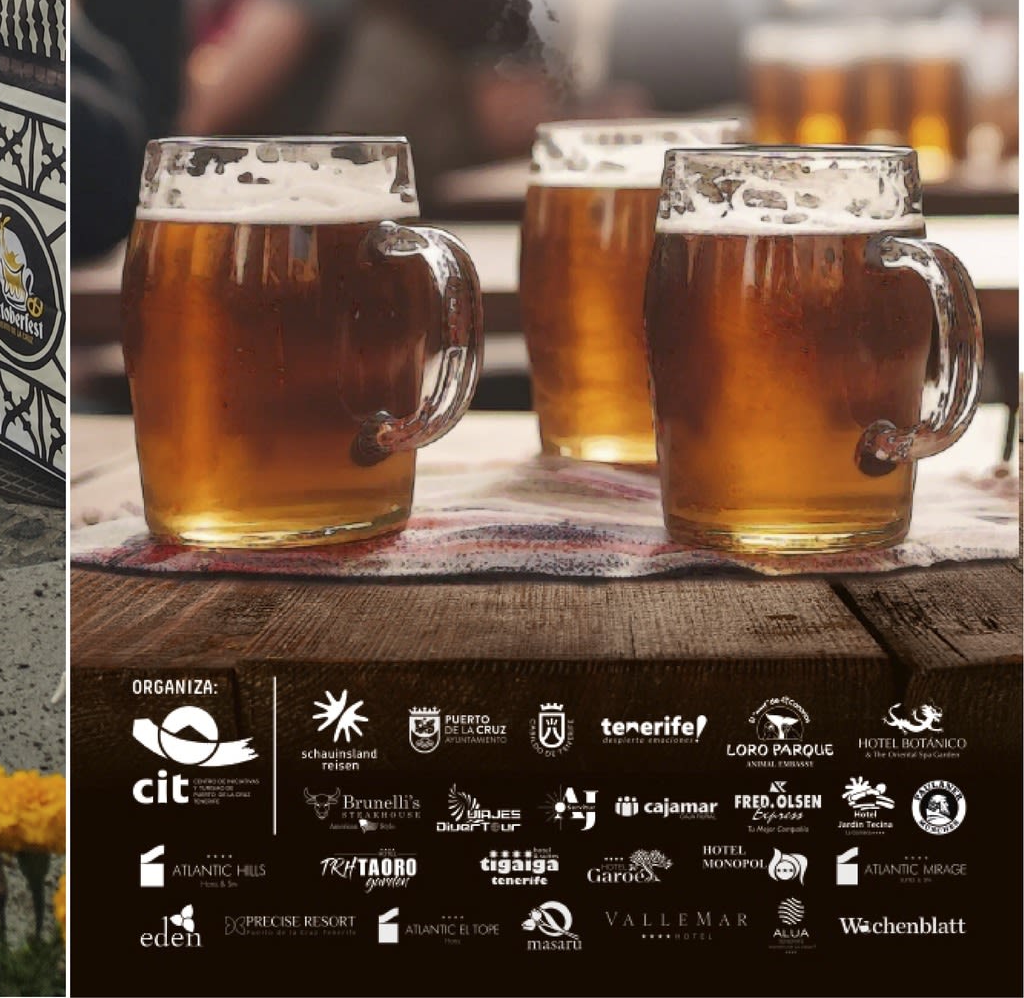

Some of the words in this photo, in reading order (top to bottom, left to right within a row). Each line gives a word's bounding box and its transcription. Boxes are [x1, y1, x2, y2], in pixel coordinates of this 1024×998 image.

[132, 679, 219, 696] ORGANIZA:
[445, 714, 490, 724] PUERTO
[445, 725, 458, 735] DE
[461, 725, 474, 735] LA
[476, 725, 507, 735] CRUZ
[445, 736, 507, 744] AYUNTAMIENTO
[858, 738, 899, 749] HOTEL
[902, 736, 967, 749] BOTÁNICO
[301, 748, 377, 759] schauinsland
[726, 744, 768, 758] LORO
[773, 744, 834, 758] PARQUE
[322, 760, 360, 771] reisen
[132, 769, 189, 804] cit
[914, 780, 963, 801] PAULANER
[342, 794, 421, 810] Brunelli's
[644, 797, 718, 818] cajamar
[342, 811, 421, 819] STEAKHOUSE
[752, 806, 804, 824] Express
[854, 810, 877, 818] Hotel
[703, 845, 746, 856] HOTEL
[172, 864, 232, 877] ATLANTIC
[237, 864, 267, 877] HILLS
[320, 856, 356, 879] TRH
[358, 857, 417, 877] TAORO
[480, 857, 559, 874] tigaiga
[702, 859, 767, 869] MONOPOL
[864, 864, 918, 876] ATLANTIC
[922, 864, 968, 876] MIRAGE
[364, 874, 411, 894] garden
[491, 875, 548, 886] tenerife
[246, 915, 301, 928] PRECISE
[304, 915, 357, 928] RESORT
[140, 915, 203, 948] eden
[405, 924, 456, 935] ATLANTIC
[459, 924, 470, 935] EL
[473, 924, 500, 935] TOPE
[772, 928, 810, 938] ALUA
